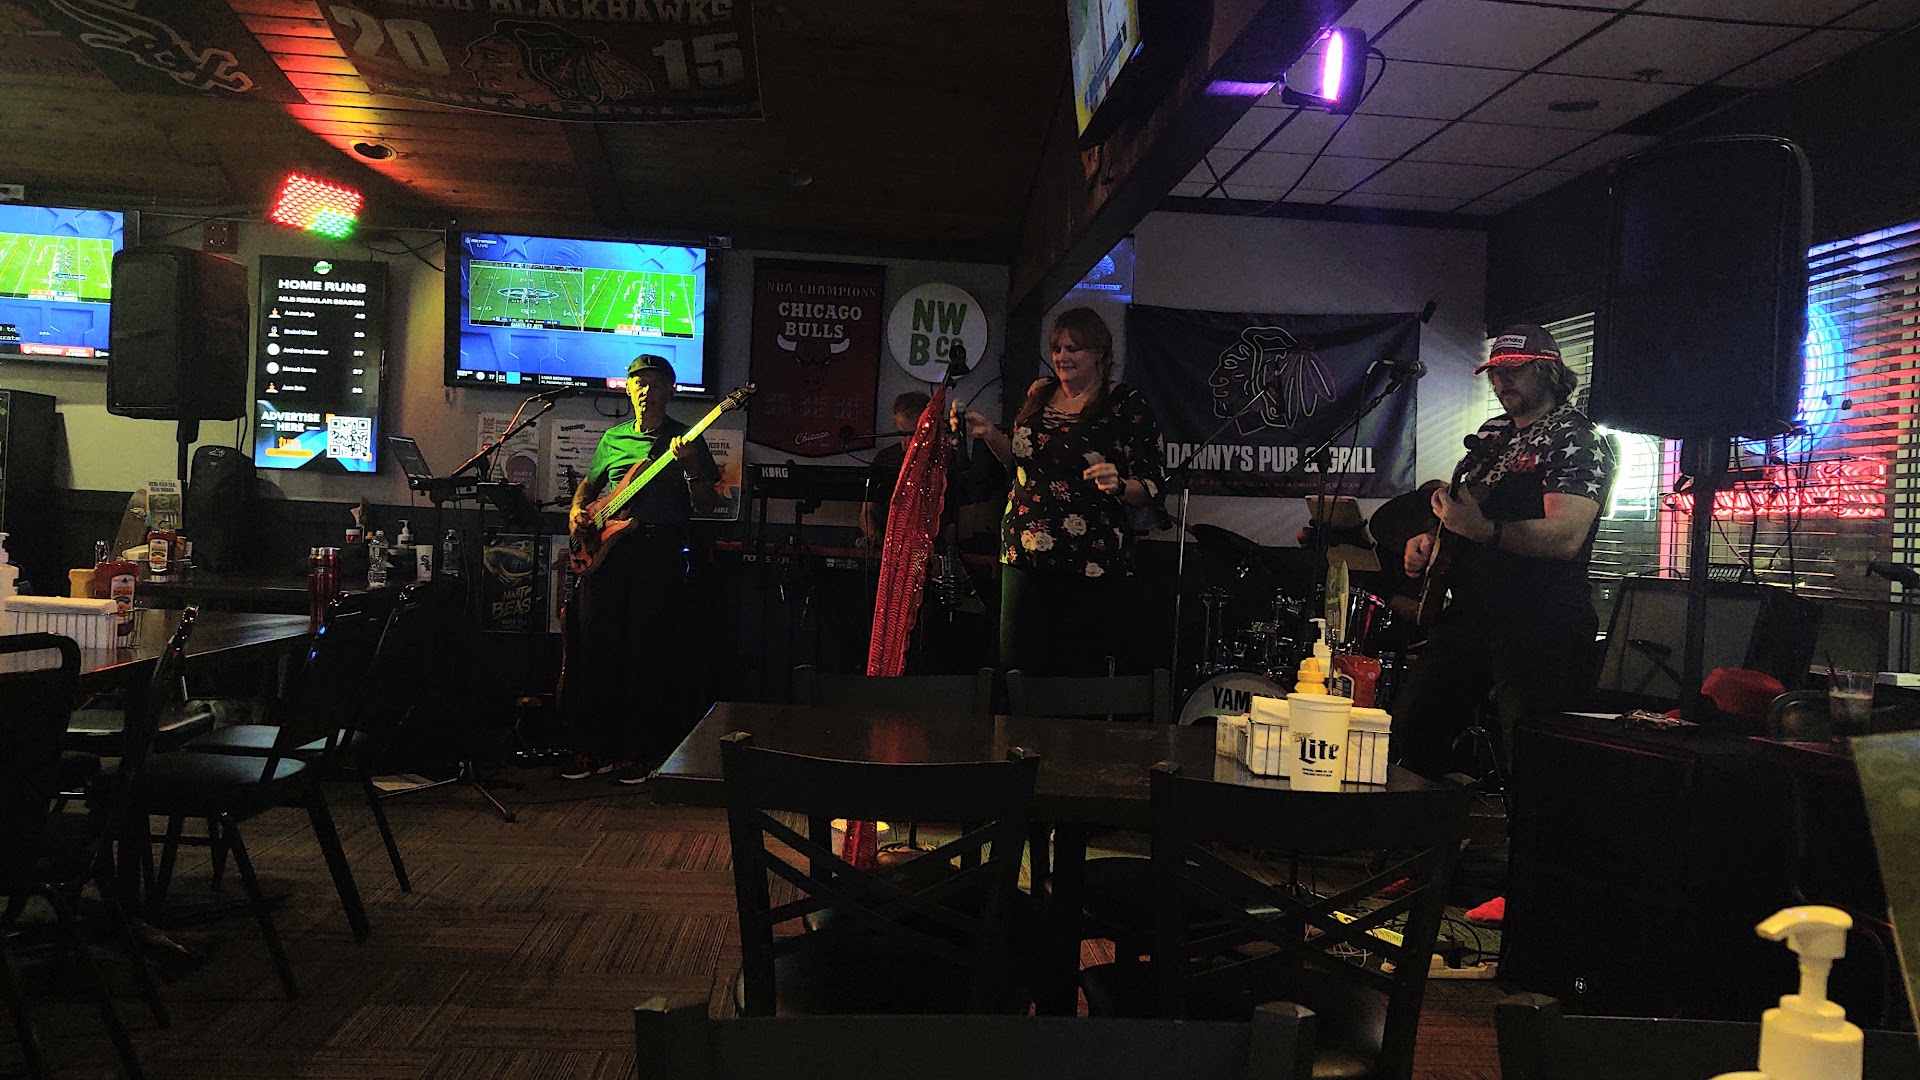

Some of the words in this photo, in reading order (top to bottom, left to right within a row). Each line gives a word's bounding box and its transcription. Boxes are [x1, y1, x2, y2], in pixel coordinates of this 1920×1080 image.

[328, 4, 451, 76] 20
[652, 31, 745, 89] 15
[278, 278, 323, 291] HOME
[323, 280, 367, 294] RUNS
[767, 280, 793, 293] NBA
[799, 283, 876, 298] CHAMPIONS
[278, 295, 296, 303] MLB
[296, 296, 333, 305] REGULAR
[333, 298, 365, 307] SEASON
[777, 301, 863, 321] CHICAGO
[912, 298, 968, 336] NW
[784, 321, 845, 340] BULLS
[909, 332, 931, 366] B
[261, 411, 321, 423] ADVERTISE
[276, 421, 305, 433] HERE
[794, 431, 830, 445] Chicago
[1167, 441, 1254, 473] DANNY'S
[1258, 446, 1299, 473] PUB
[1304, 446, 1320, 473] &
[1328, 446, 1376, 474] GRILL
[761, 466, 789, 479] KORG
[1212, 686, 1256, 714] YAM
[1298, 736, 1340, 765] Lite
